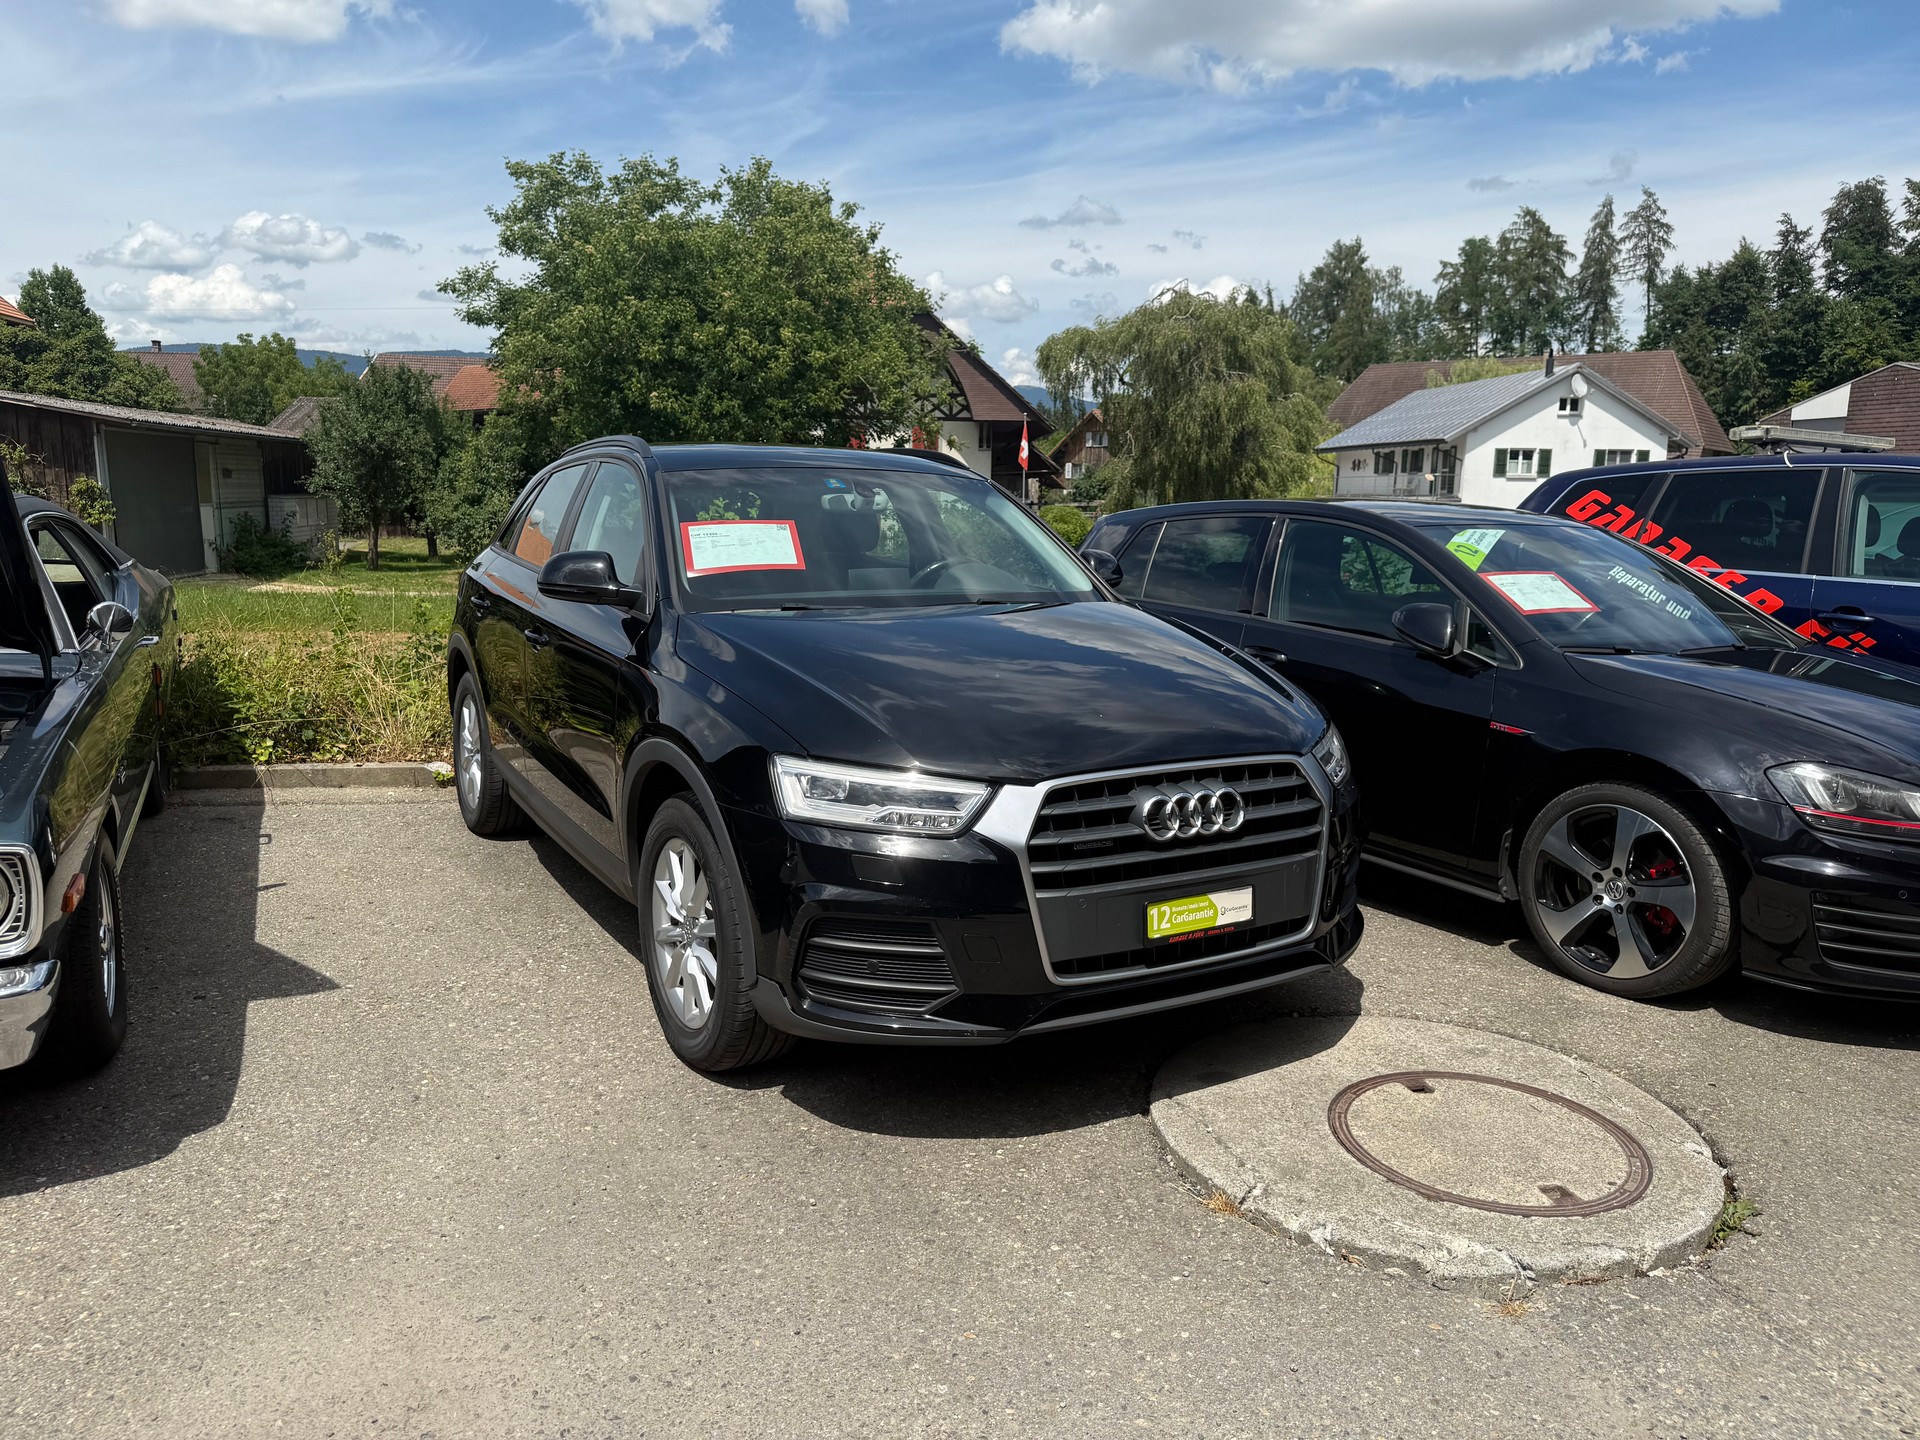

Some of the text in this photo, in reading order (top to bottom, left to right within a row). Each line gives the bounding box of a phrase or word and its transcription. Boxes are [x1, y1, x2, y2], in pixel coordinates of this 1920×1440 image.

[1454, 545, 1479, 557] 12
[1609, 565, 1692, 620] Reparatur und
[1150, 906, 1171, 931] 12
[1172, 908, 1214, 924] CarGarantie
